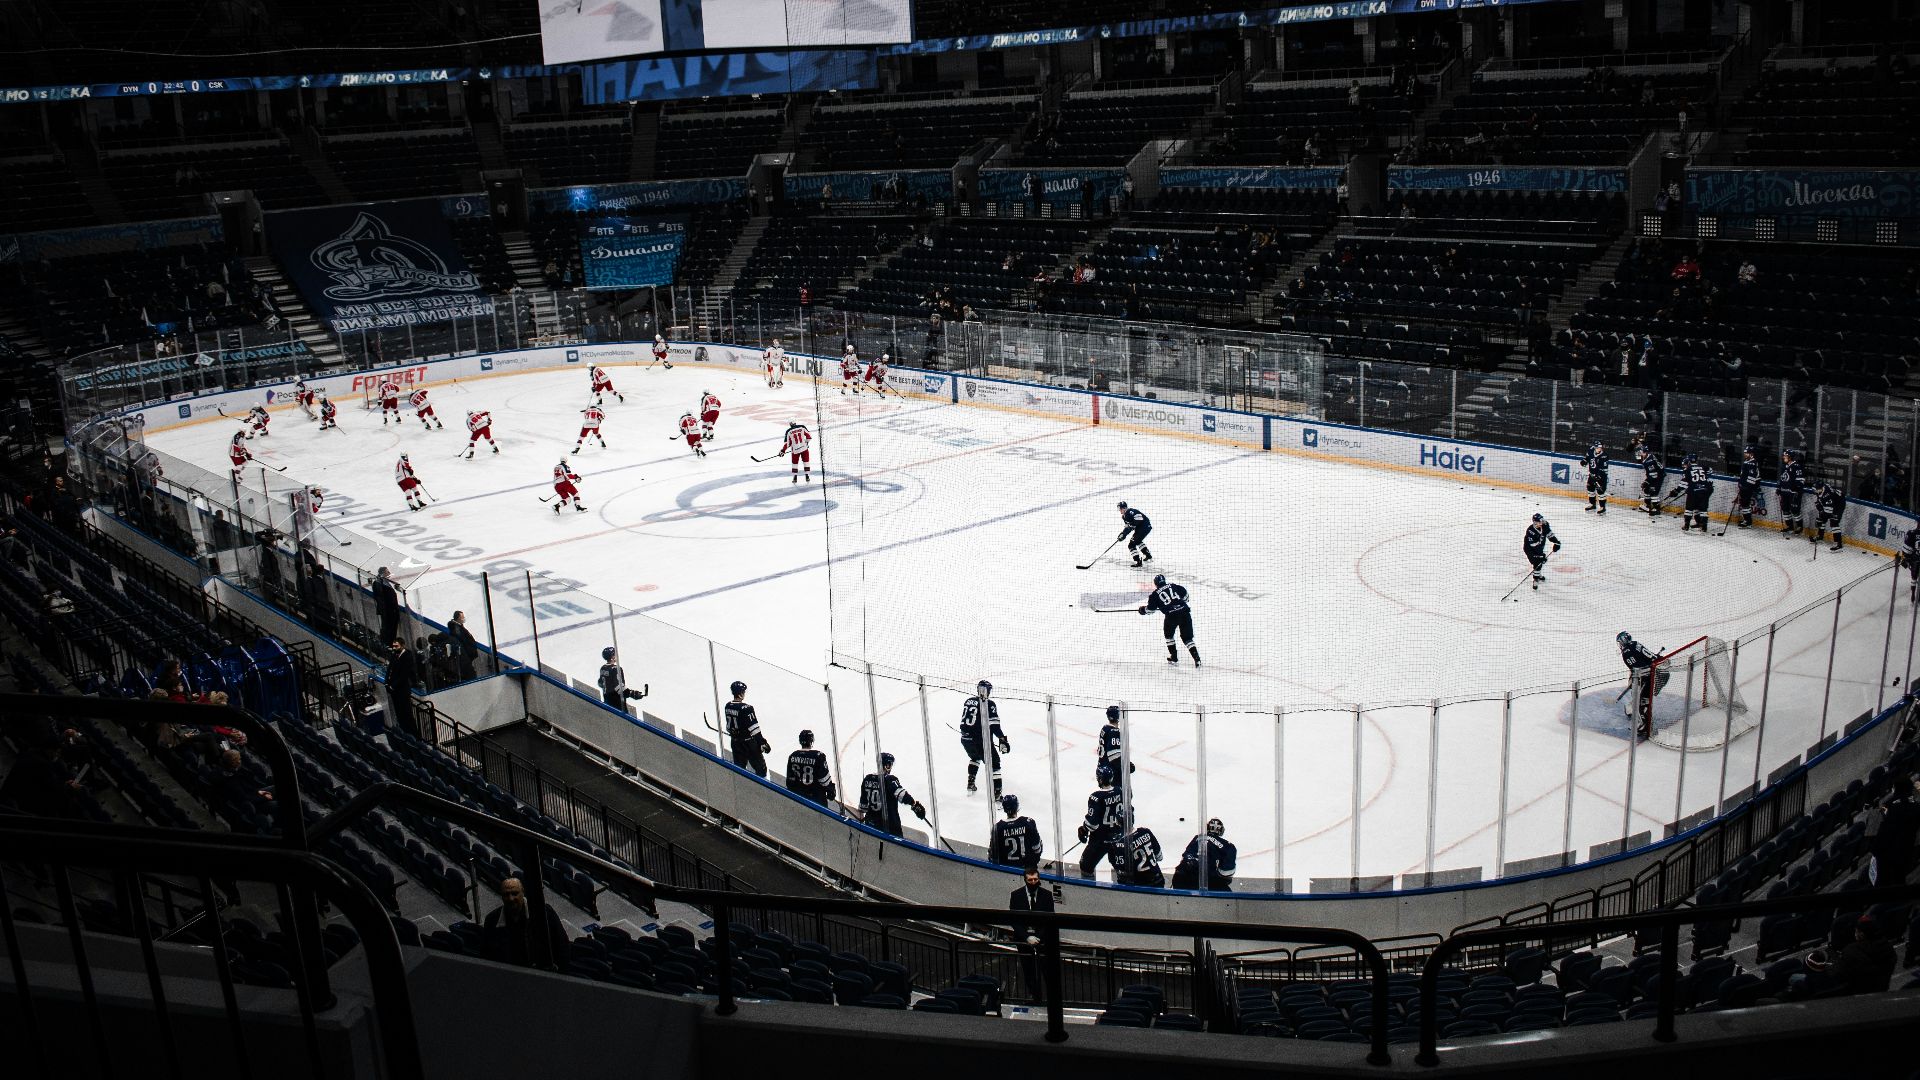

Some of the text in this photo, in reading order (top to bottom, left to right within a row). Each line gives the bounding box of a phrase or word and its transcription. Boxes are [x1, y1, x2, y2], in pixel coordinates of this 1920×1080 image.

[1278, 6, 1333, 24] ДИНАМО
[1350, 0, 1387, 16] ЦСКА
[991, 32, 1039, 48] ДИНАМО
[123, 85, 139, 93] DYN
[149, 82, 157, 93] 0
[191, 81, 199, 92] 0
[208, 81, 224, 89] CSK
[340, 73, 395, 87] ДИНАМО
[1022, 172, 1079, 197] Днамо
[1467, 169, 1501, 187] 1946
[643, 189, 670, 203] 1946
[1785, 179, 1877, 208] Москва
[597, 227, 615, 236] ВТБ
[631, 225, 650, 234] ВТБ
[666, 223, 684, 232] ВТБ
[590, 243, 674, 259] Динамо
[404, 271, 471, 286] МОСКВА
[332, 302, 494, 332] ДИНАМО МОСКВА
[785, 355, 823, 377] HL.RU
[1122, 404, 1186, 425] МЕГАФОН
[793, 432, 803, 444] 11
[1420, 443, 1485, 473] Haier
[1690, 469, 1707, 483] 55
[1158, 588, 1180, 605] 94
[1005, 836, 1026, 860] 21
[1115, 855, 1125, 865] 25
[1133, 841, 1157, 872] 25
